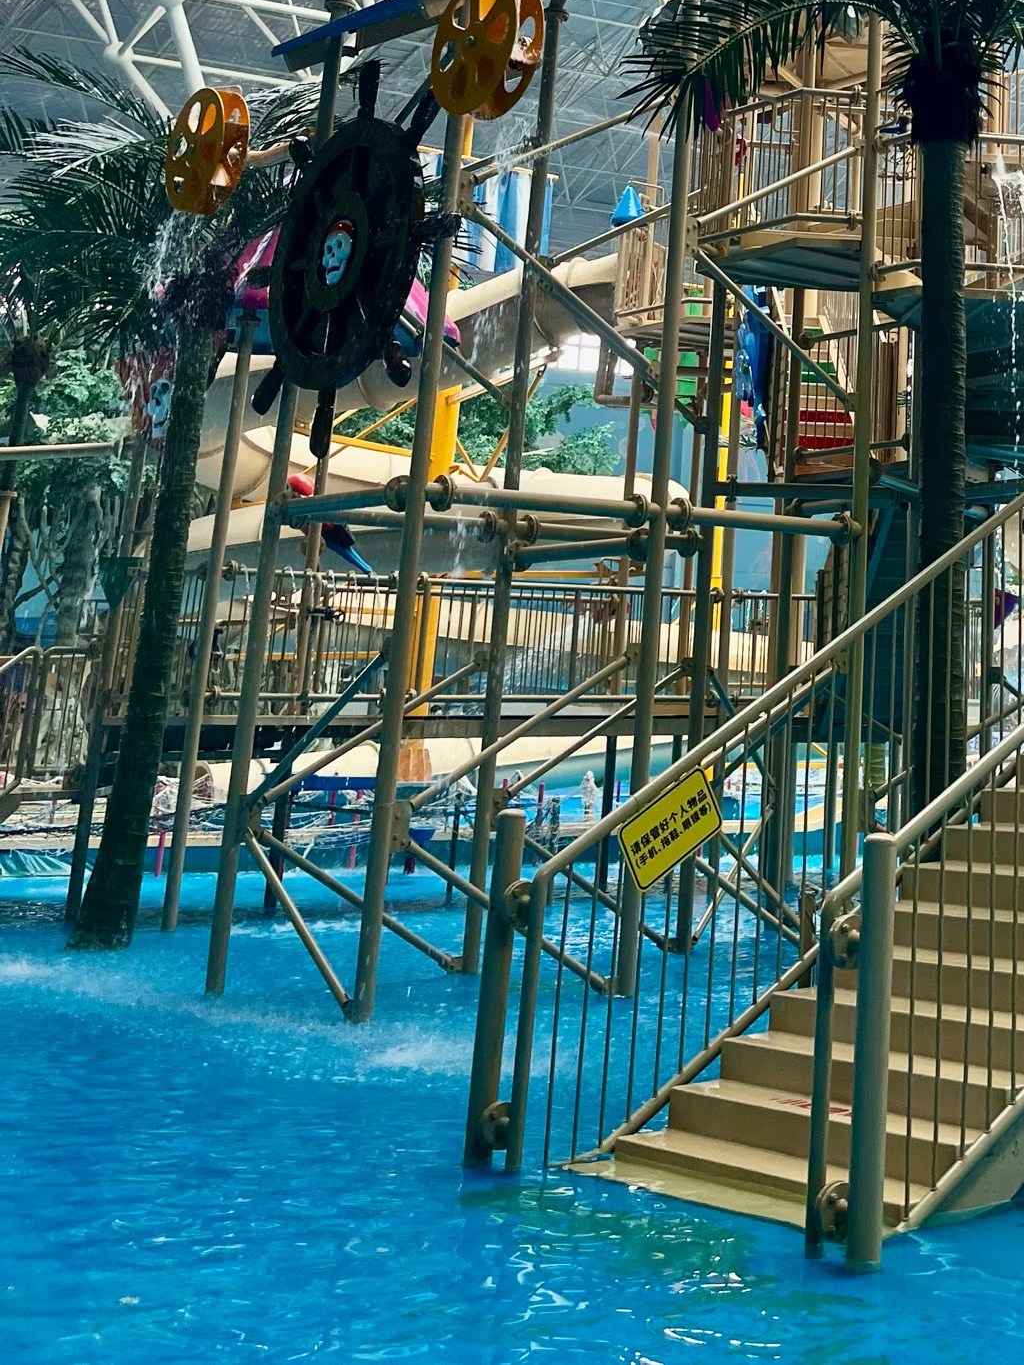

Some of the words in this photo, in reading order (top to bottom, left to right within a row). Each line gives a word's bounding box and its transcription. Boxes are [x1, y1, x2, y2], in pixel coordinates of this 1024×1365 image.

[630, 788, 708, 856] 请保管好个人物品
